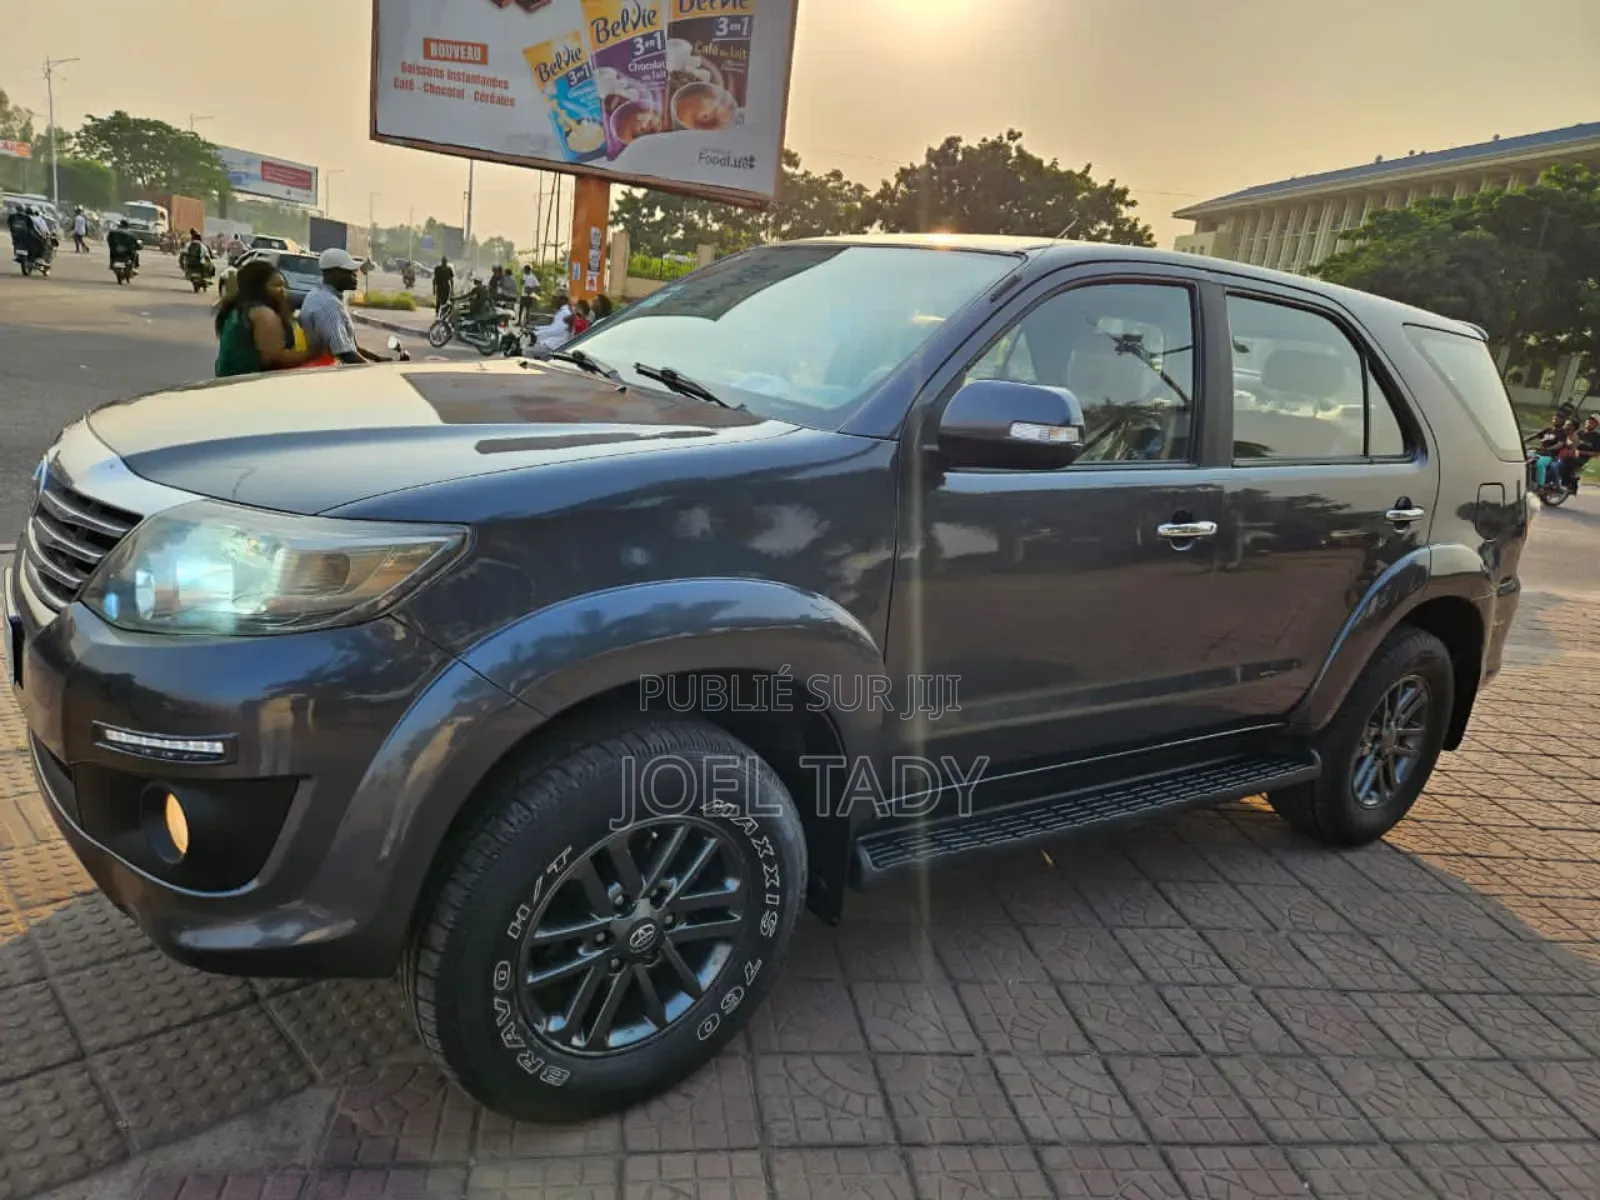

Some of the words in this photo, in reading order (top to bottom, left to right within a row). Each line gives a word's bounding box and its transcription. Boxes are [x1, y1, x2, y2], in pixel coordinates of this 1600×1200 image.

[430, 41, 481, 61] NOUVEAU
[424, 82, 465, 100] Chocolat
[700, 799, 780, 938] MAXXIS
[493, 960, 571, 1086] BRAVO
